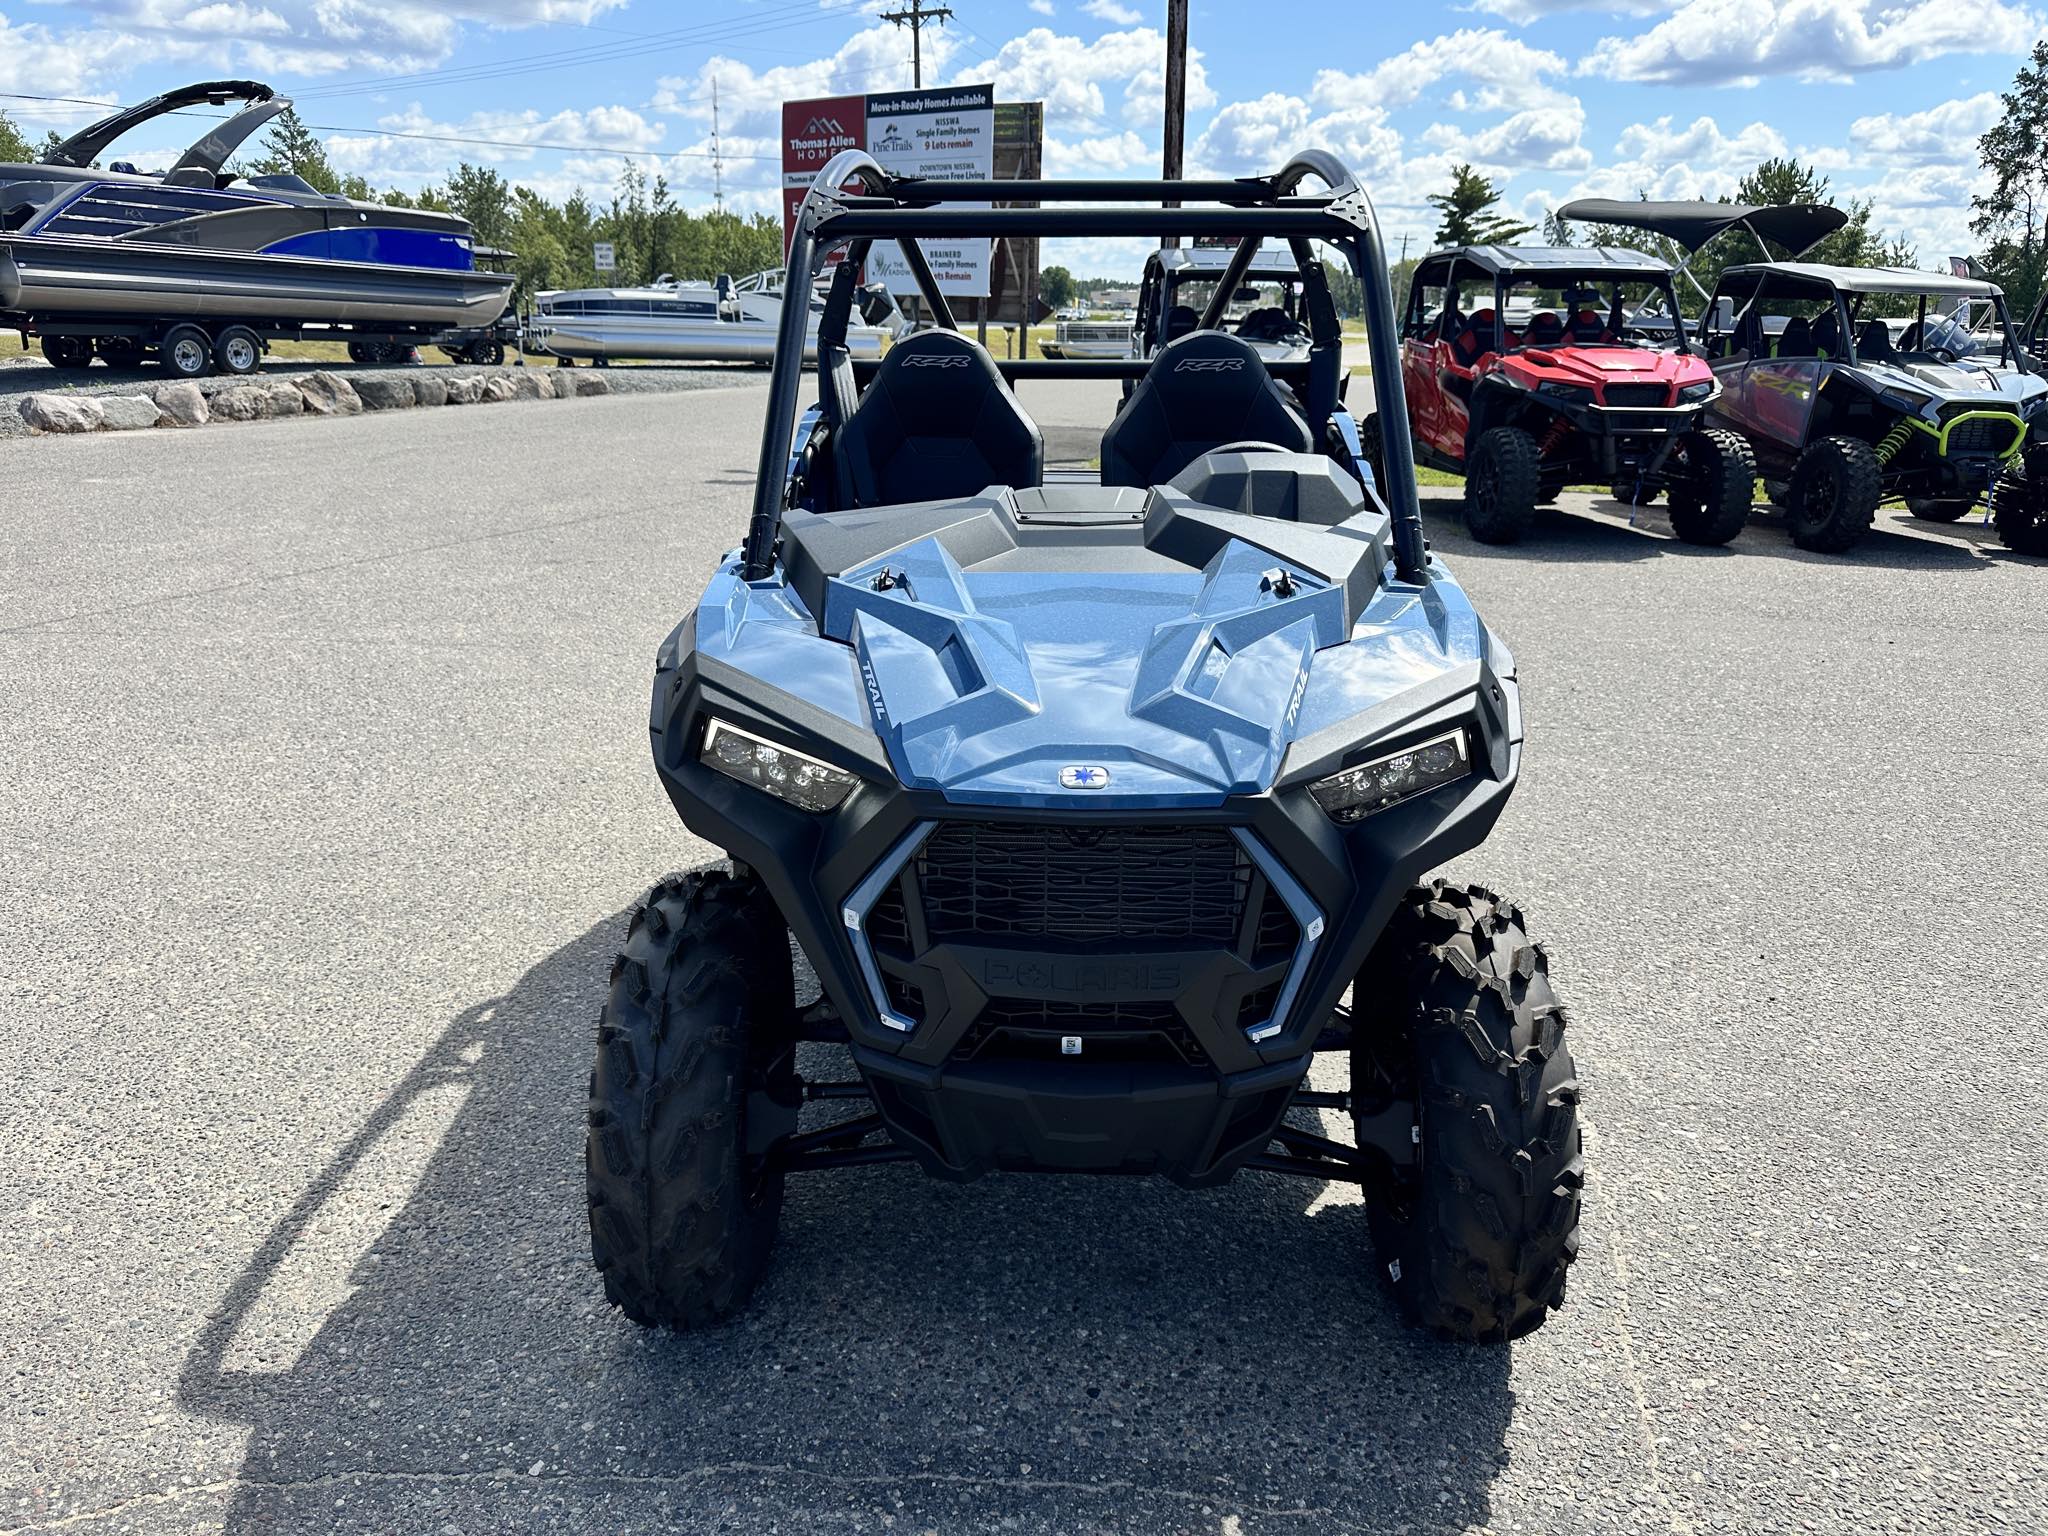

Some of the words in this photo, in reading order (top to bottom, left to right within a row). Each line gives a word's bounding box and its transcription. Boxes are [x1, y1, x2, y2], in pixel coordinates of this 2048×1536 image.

[871, 99, 923, 113] Move-in-Ready
[924, 98, 950, 109] Homes
[951, 94, 986, 107] Available
[935, 117, 960, 126] NISSWA
[916, 128, 935, 139] Single
[936, 127, 957, 138] Family
[958, 127, 980, 135] Homes
[790, 138, 828, 149] Thomas
[829, 136, 855, 147] Allen
[873, 142, 889, 153] Pine
[891, 140, 913, 152] Trails
[924, 142, 930, 150] 9
[932, 141, 947, 150] Lots
[948, 139, 973, 149] remain
[797, 149, 846, 160] HOME
[951, 172, 964, 180] Free
[965, 170, 985, 180] Living
[125, 208, 144, 219] RX
[934, 260, 955, 270] Family
[956, 260, 977, 269] Homes
[945, 271, 972, 281] Remain
[901, 354, 971, 368] RZR
[1174, 358, 1246, 372] RZR
[862, 660, 885, 721] TRAIL
[1287, 668, 1308, 728] TRAIL
[984, 957, 1181, 991] POLARIS
